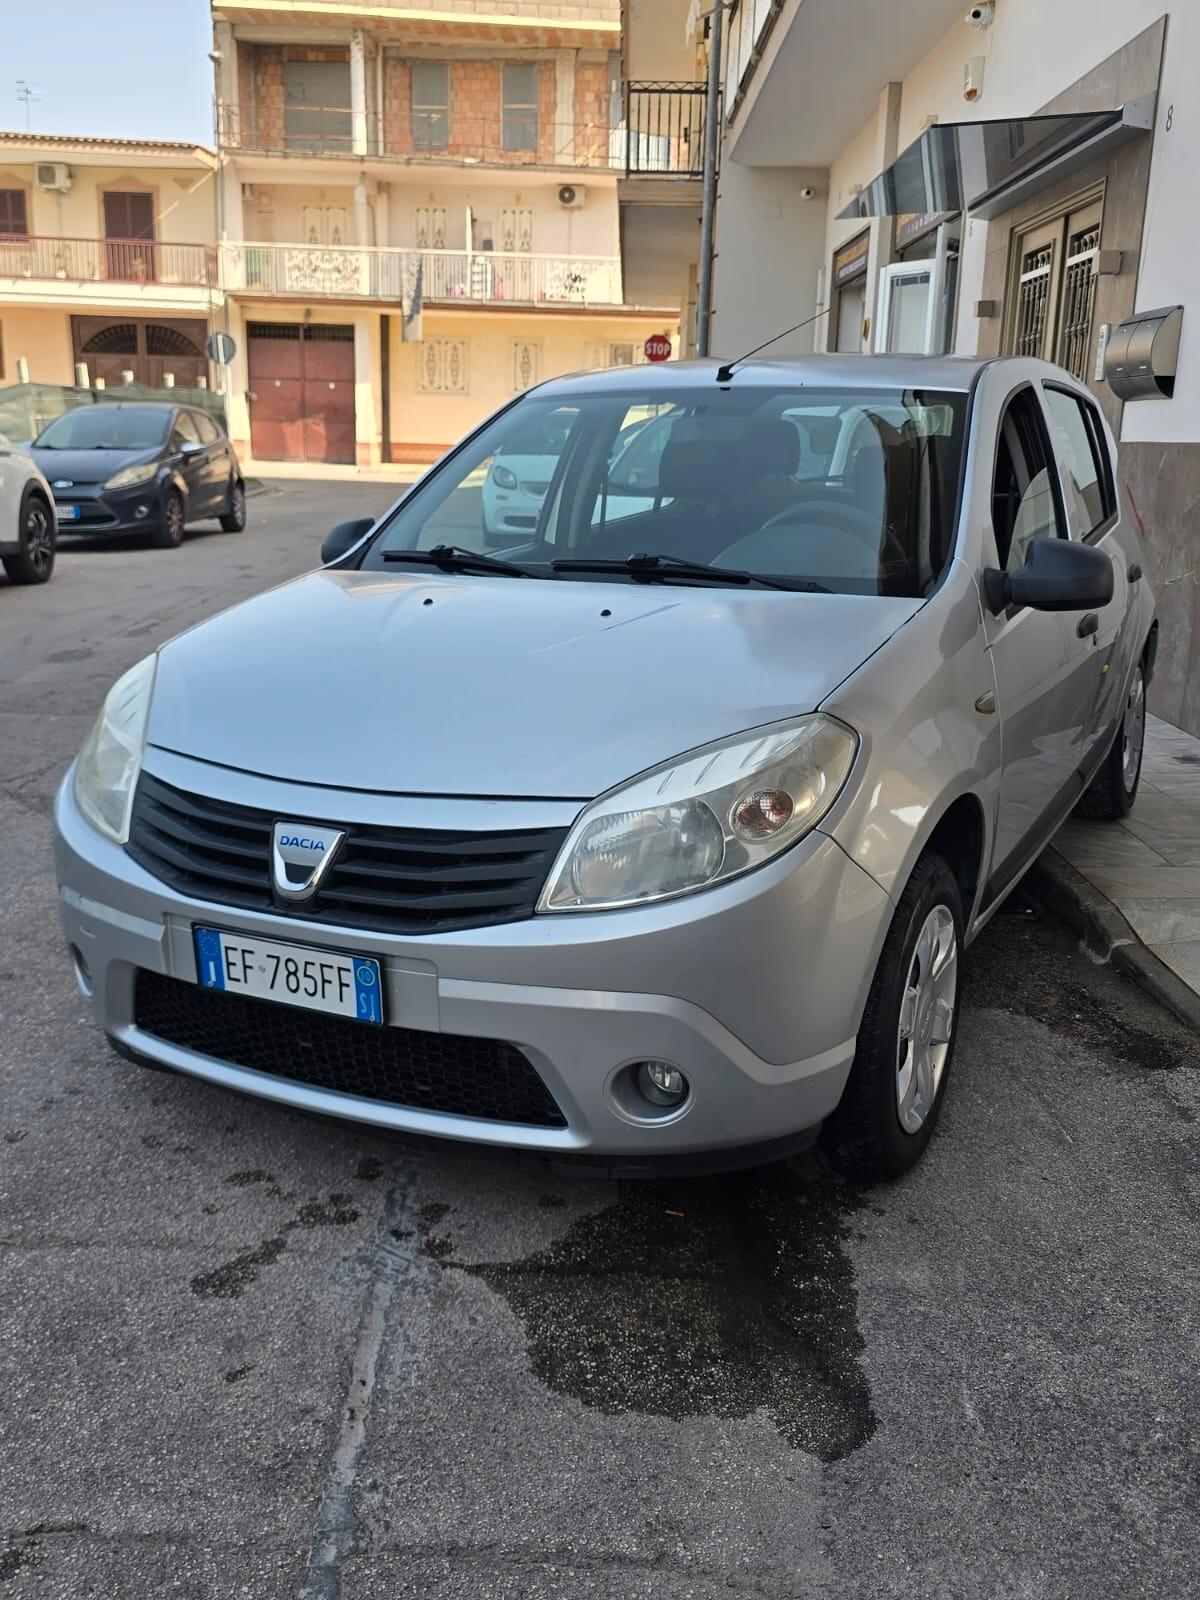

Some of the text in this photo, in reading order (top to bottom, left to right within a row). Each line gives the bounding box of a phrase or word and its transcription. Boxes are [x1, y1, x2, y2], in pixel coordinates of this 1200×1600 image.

[1166, 104, 1174, 132] 8
[646, 342, 670, 355] STOP
[279, 835, 325, 851] DACIA
